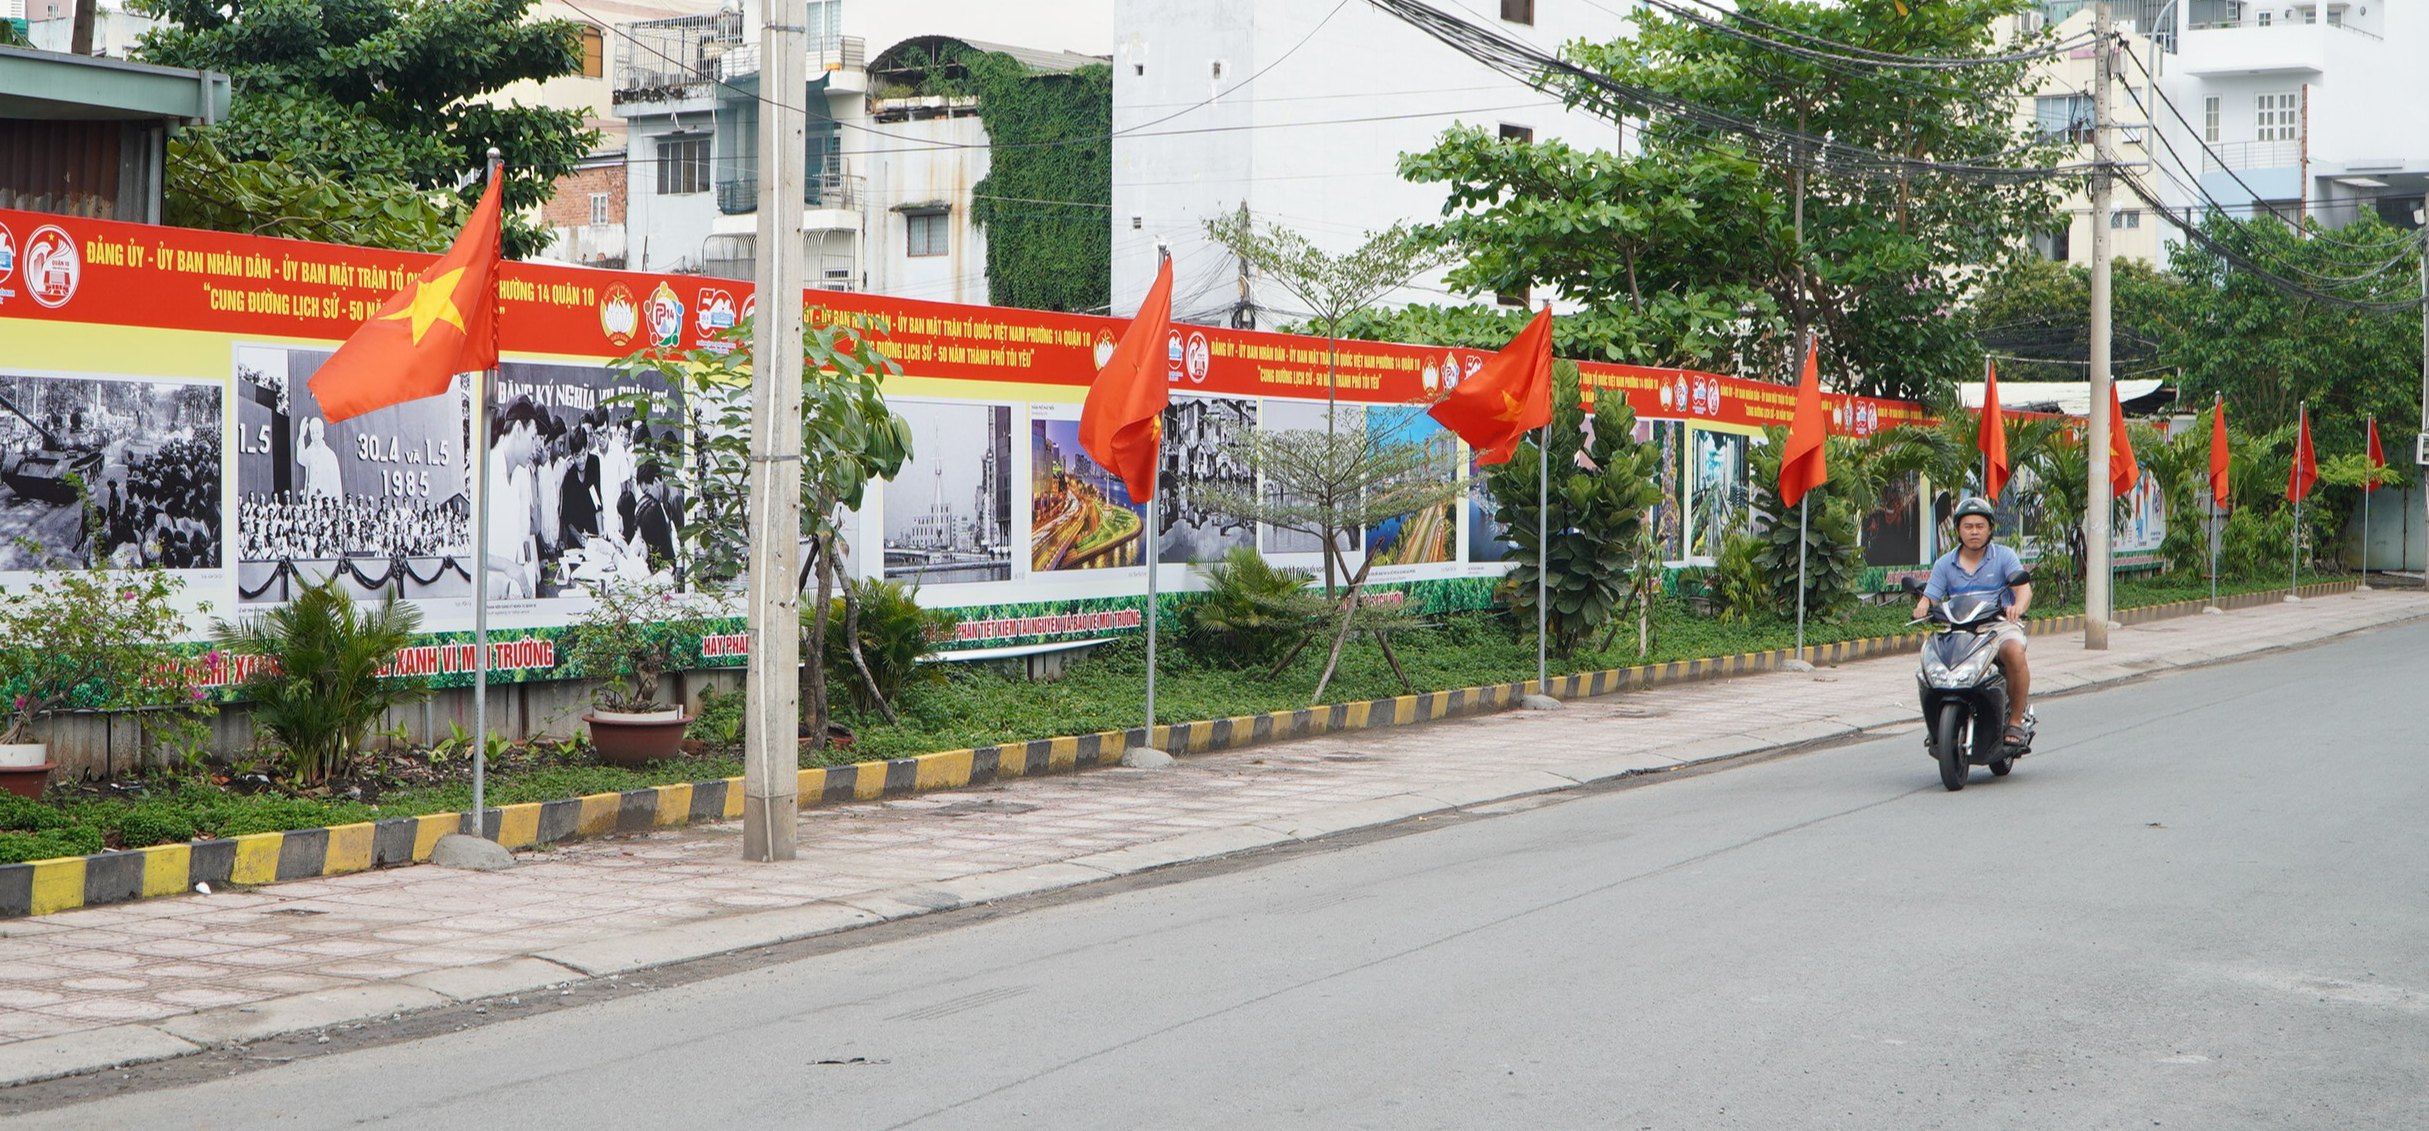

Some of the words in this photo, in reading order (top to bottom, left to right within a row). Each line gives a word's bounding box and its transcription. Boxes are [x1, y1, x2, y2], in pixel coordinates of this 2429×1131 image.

[86, 235, 124, 266] ĐẢNG
[127, 238, 144, 267] ỦY
[157, 241, 174, 271] ỦY
[177, 250, 204, 273] BAN
[207, 251, 242, 277] NHÂN
[245, 253, 271, 279] DÂN
[283, 253, 298, 281] ỦY
[301, 262, 326, 284] BAN
[329, 262, 354, 291] MẶT
[357, 265, 387, 293] TRẬN
[390, 264, 404, 292] TỔ
[247, 288, 290, 316] ĐƯỜNG
[292, 295, 319, 321] LỊCH
[322, 292, 339, 319] SỬ
[350, 301, 363, 321] 50
[499, 276, 535, 302] HƯỜNG
[537, 284, 550, 304] 14
[552, 282, 581, 309] QUẬN
[582, 288, 595, 307] 10
[833, 310, 850, 328] BAN
[898, 310, 908, 333] ỦY
[909, 316, 924, 334] BAN
[926, 316, 943, 339] MẶT
[943, 317, 962, 341] TRẬN
[963, 316, 973, 338] TỔ
[973, 318, 992, 341] QUỐC
[993, 322, 1008, 344] VIỆT
[1009, 326, 1025, 341] NAM
[1026, 325, 1053, 344] PHƯỜNG
[1054, 330, 1062, 345] 14
[1064, 328, 1081, 350] QUẬN
[1082, 332, 1091, 347] 10
[904, 343, 920, 363] LỊCH
[922, 340, 932, 361] SỬ
[938, 347, 947, 362] 50
[949, 345, 966, 363] NĂM
[966, 345, 989, 366] THÀNH
[990, 345, 1005, 366] PHỐ
[1006, 347, 1017, 367] TÔI
[535, 378, 553, 407] KÝ
[555, 383, 596, 411] NGHĨA
[381, 469, 430, 498] 1985
[956, 617, 978, 640] PHẦN
[979, 615, 997, 639] TIẾT
[997, 616, 1017, 641] KIỆM
[1018, 614, 1031, 636] TÀI
[1031, 613, 1060, 634] NGUYÊN
[1061, 611, 1072, 632] VÀ
[1073, 608, 1088, 631] BẢO
[1088, 610, 1098, 634] VỆ
[1099, 609, 1112, 630] MÔI
[1113, 606, 1141, 628] TRƯỜNG
[393, 647, 438, 677] XANH
[441, 639, 459, 673] VÌ
[461, 644, 492, 672] MI
[494, 634, 554, 669] TRƯỜNG
[703, 632, 724, 657] HÃY
